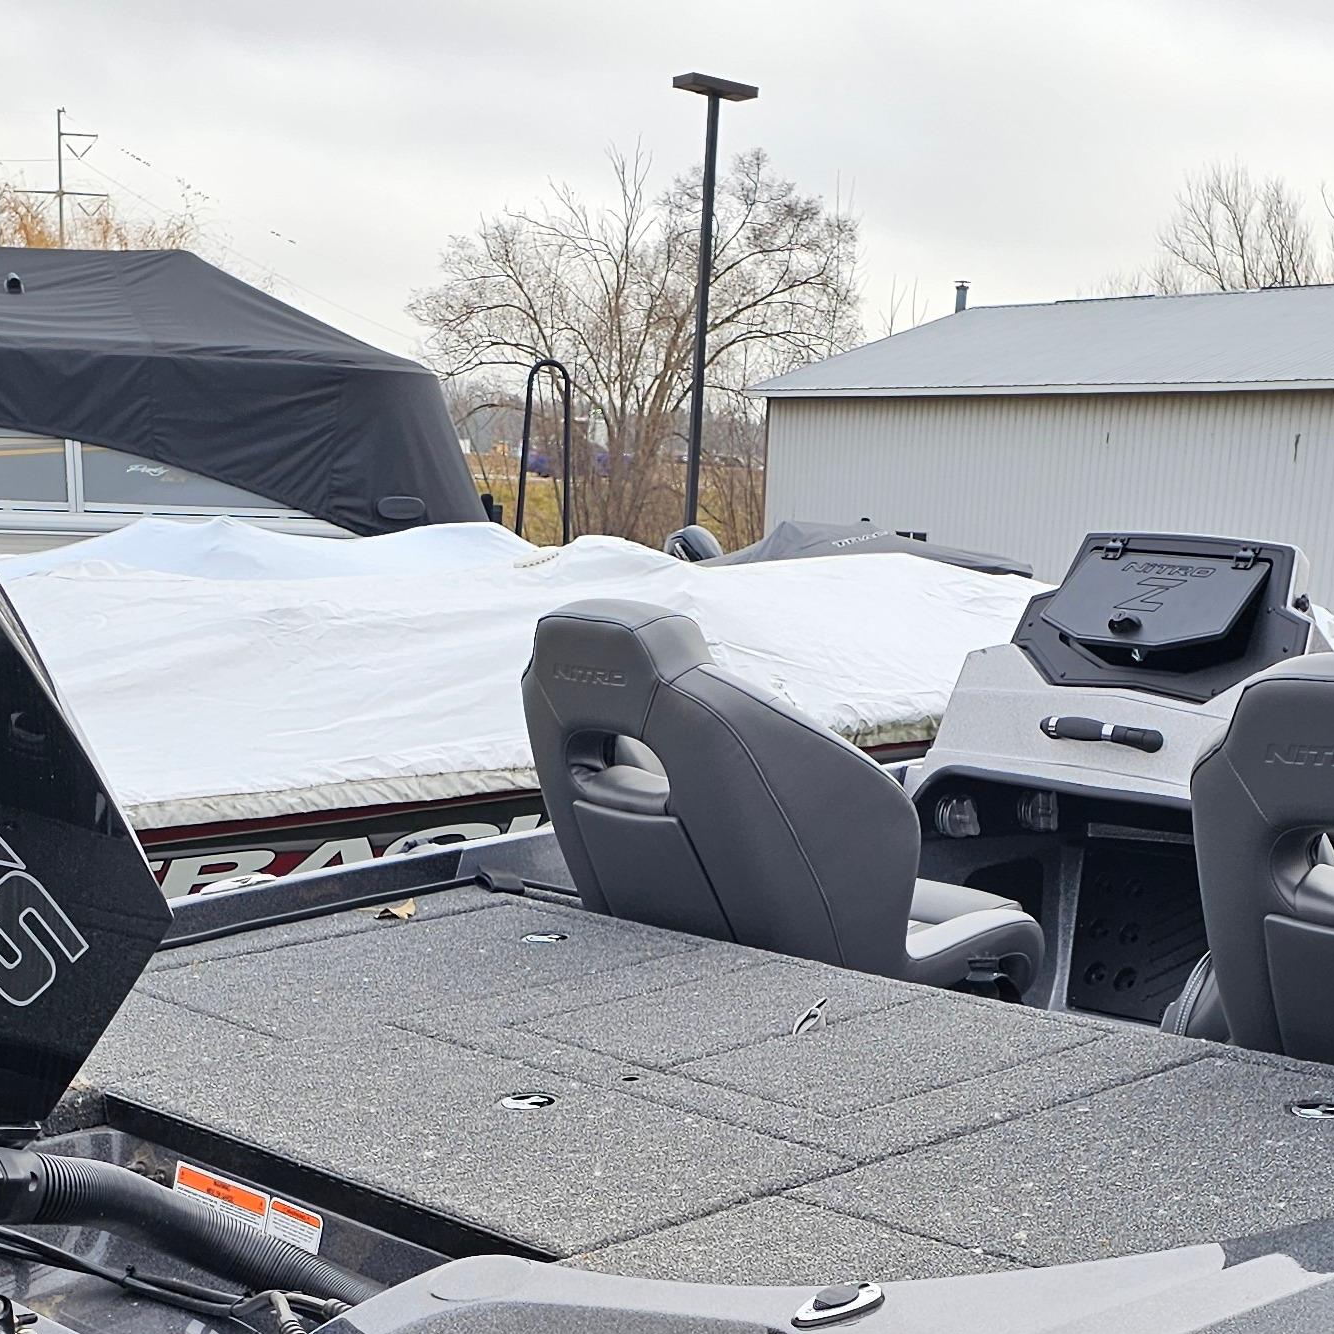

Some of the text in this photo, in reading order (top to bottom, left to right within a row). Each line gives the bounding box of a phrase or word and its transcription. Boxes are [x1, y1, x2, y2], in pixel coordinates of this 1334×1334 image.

[1121, 561, 1217, 578] NITRO
[1113, 577, 1188, 612] Z
[551, 663, 628, 687] NITRO
